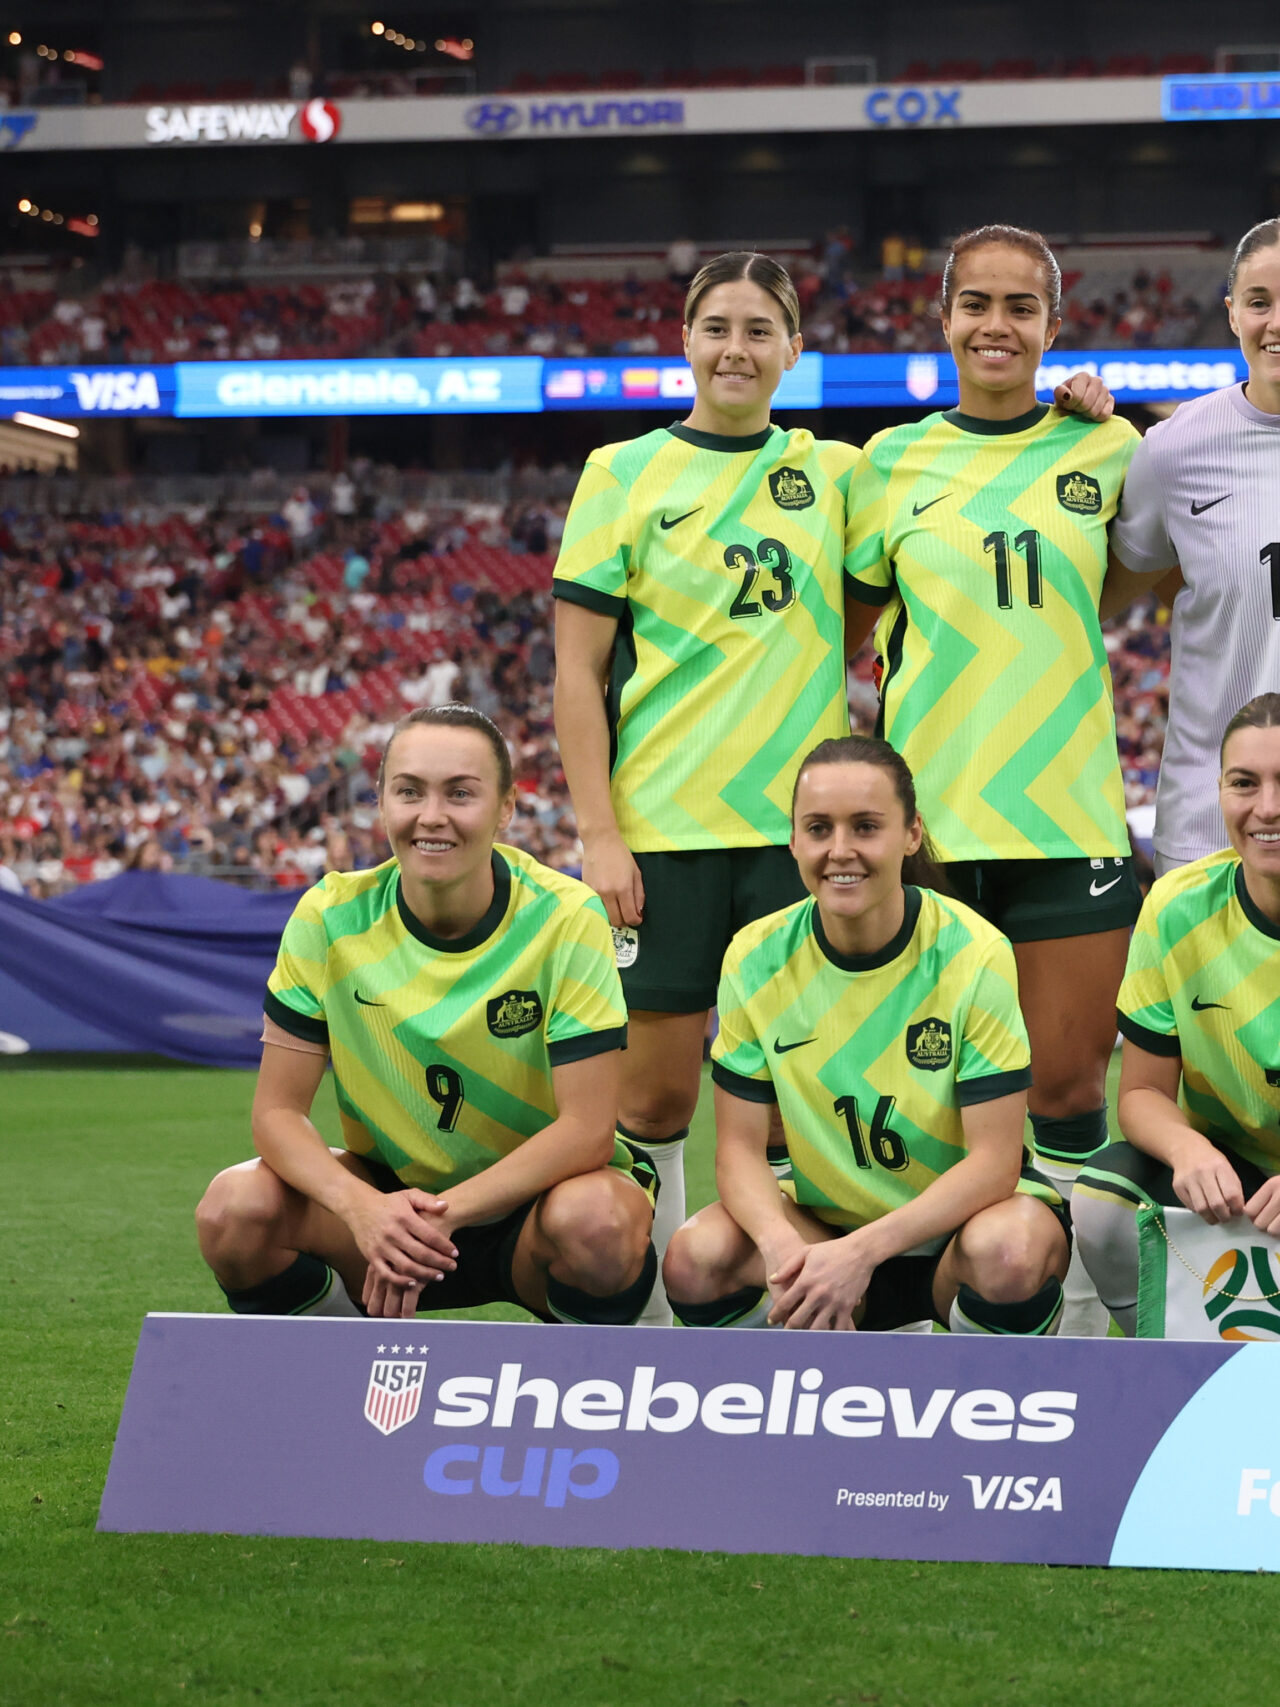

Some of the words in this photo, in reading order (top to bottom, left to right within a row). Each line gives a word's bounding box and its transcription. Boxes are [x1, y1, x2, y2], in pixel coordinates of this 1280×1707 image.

[146, 103, 297, 142] SAFEWAY
[529, 100, 684, 127] HYUNDAI
[864, 88, 962, 125] COX
[70, 371, 160, 410] VISA
[217, 369, 431, 408] Glendale,
[435, 368, 502, 401] AZ
[723, 538, 797, 619] 23
[983, 530, 1043, 610] 11
[425, 1064, 465, 1133] 9
[833, 1095, 909, 1172] 16
[373, 1365, 423, 1393] USA
[433, 1363, 1078, 1443] shebelieves
[423, 1444, 620, 1508] cup
[836, 1488, 925, 1509] Presented
[927, 1491, 950, 1512] by
[962, 1474, 1063, 1511] VISA
